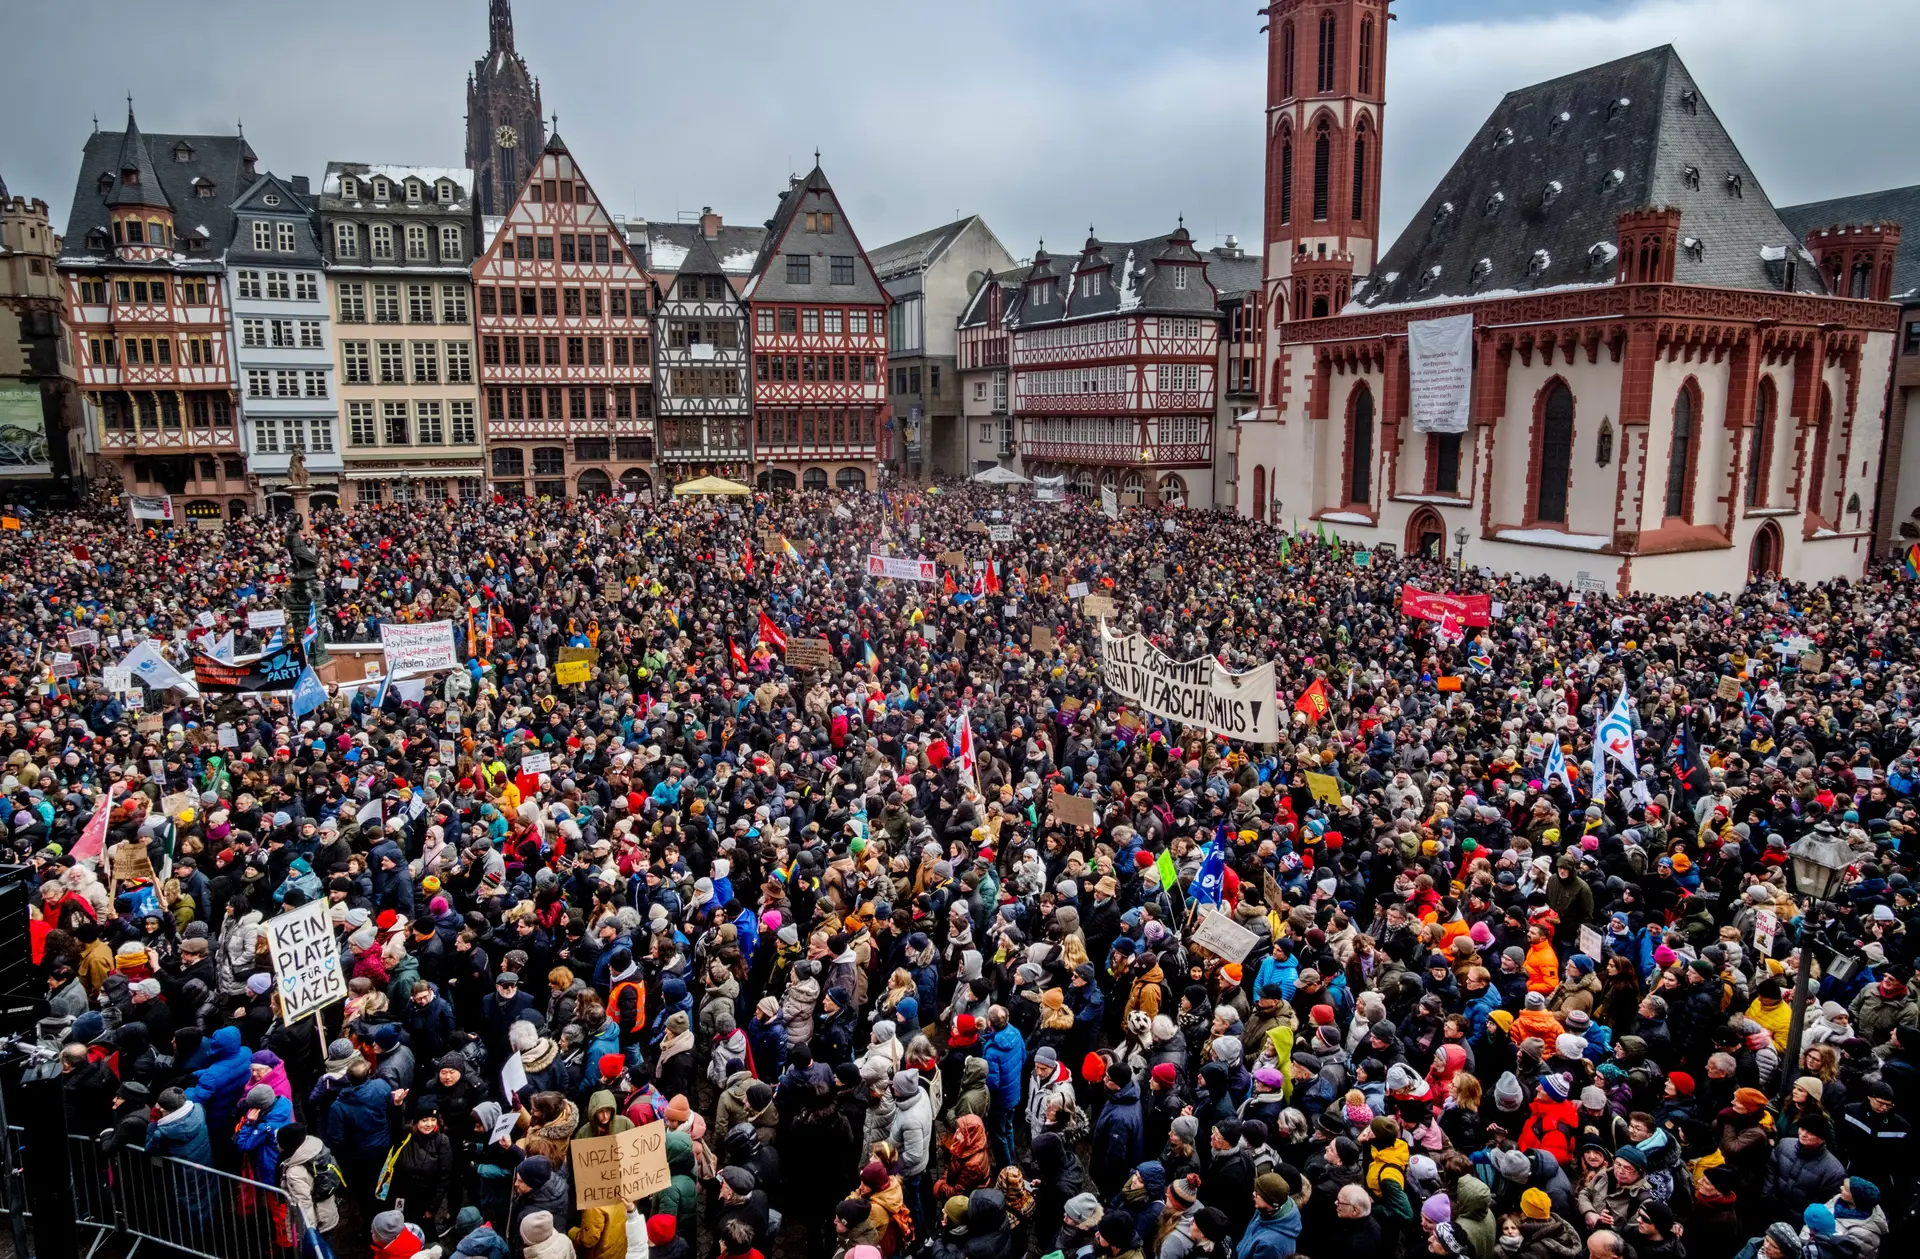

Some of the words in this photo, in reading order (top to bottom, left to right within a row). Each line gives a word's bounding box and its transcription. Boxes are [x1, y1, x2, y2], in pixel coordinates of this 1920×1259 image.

[352, 460, 398, 469] Souvenirs
[429, 459, 480, 467] Geschenke
[386, 636, 422, 647] Asylrecht
[274, 911, 327, 950] KEIN
[277, 935, 335, 977] PLATZ
[300, 965, 322, 983] FÜR
[284, 968, 340, 1015] NAZIS
[7, 1005, 34, 1014] SHURE
